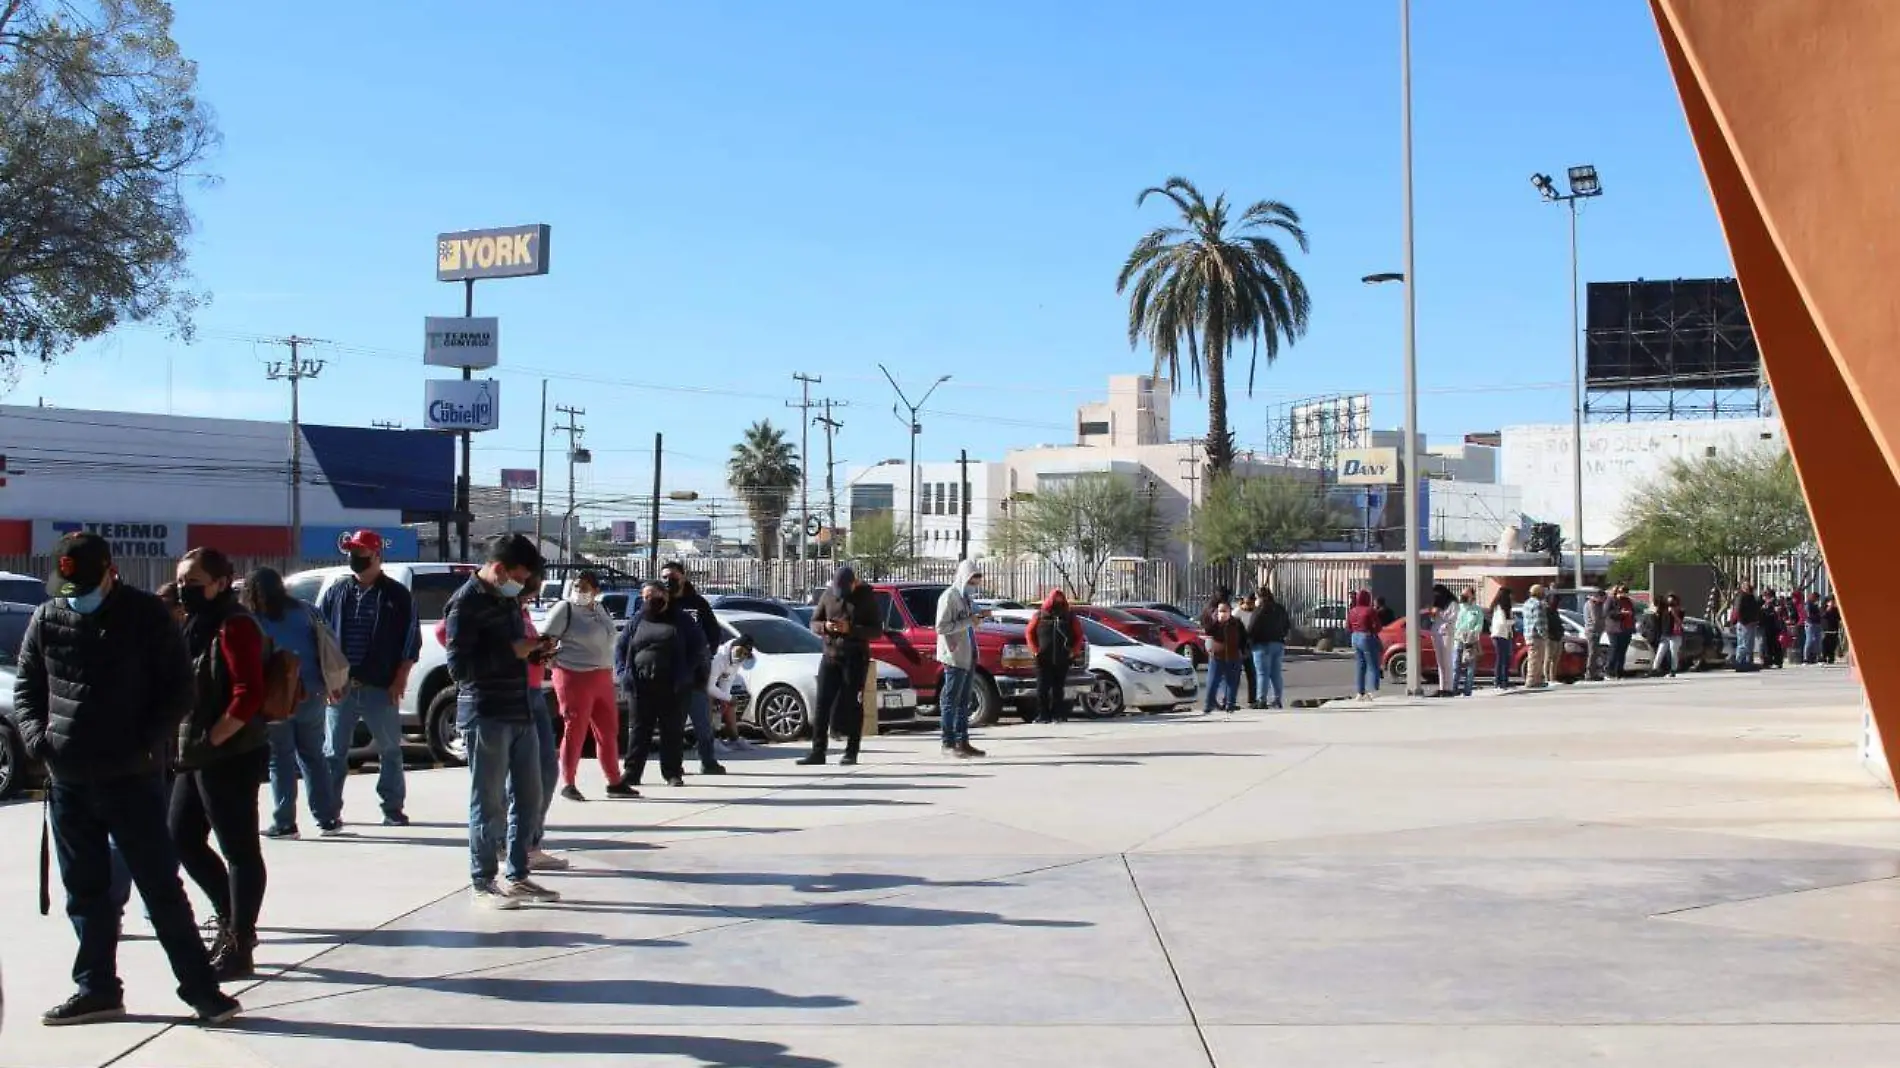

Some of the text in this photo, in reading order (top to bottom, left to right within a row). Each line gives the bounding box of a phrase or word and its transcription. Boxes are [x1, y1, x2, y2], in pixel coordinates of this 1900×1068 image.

[460, 232, 532, 269] YORK
[443, 332, 490, 340] TERMO
[443, 339, 491, 347] CONTROL
[84, 522, 168, 540] TERMO
[110, 541, 168, 558] NTROL
